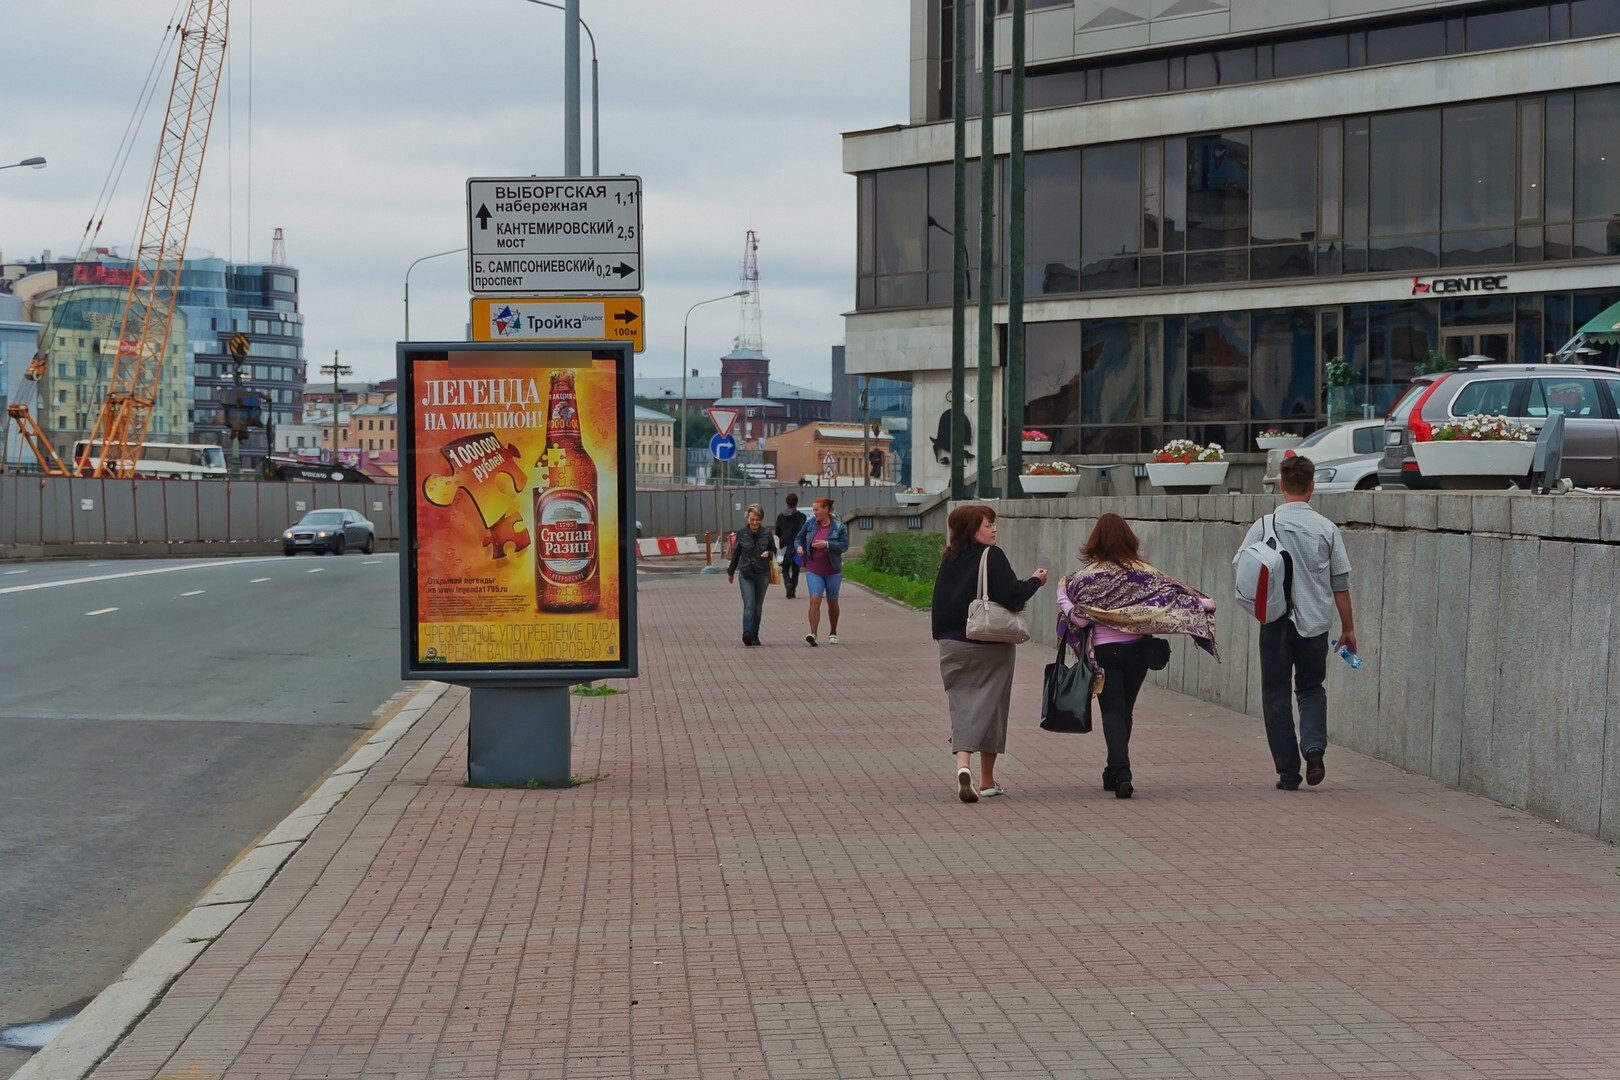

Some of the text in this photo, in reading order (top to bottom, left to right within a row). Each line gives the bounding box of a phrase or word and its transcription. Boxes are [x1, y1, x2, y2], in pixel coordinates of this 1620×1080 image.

[496, 186, 634, 206] ВЫБОРГСКАЯ 1,1
[496, 200, 588, 215] набережная
[496, 219, 635, 241] КАНТЕМИРОВСКИЙ 2,5
[496, 238, 526, 248] мост
[475, 257, 611, 279] Б. САМПСОНИЕВСКИЙ 0,2
[475, 276, 523, 289] проспект
[527, 315, 582, 332] Тройка
[422, 378, 541, 411] ЛЕГЕНДА
[424, 411, 544, 431] НА МИЛЛИОН!
[301, 470, 327, 479] VOLVO
[471, 451, 505, 483] рублей
[541, 528, 592, 542] Степан
[545, 541, 590, 555] Разин
[438, 586, 508, 595] www.legenda1795.ru
[424, 622, 617, 643] ЧРЕЗМЕРНОЕ УПОТРЕБЛЕНИЕ ПИВА
[440, 641, 601, 661] ВРЕДИТ ВАШЕМУ ЗДОРОВЬЮ
